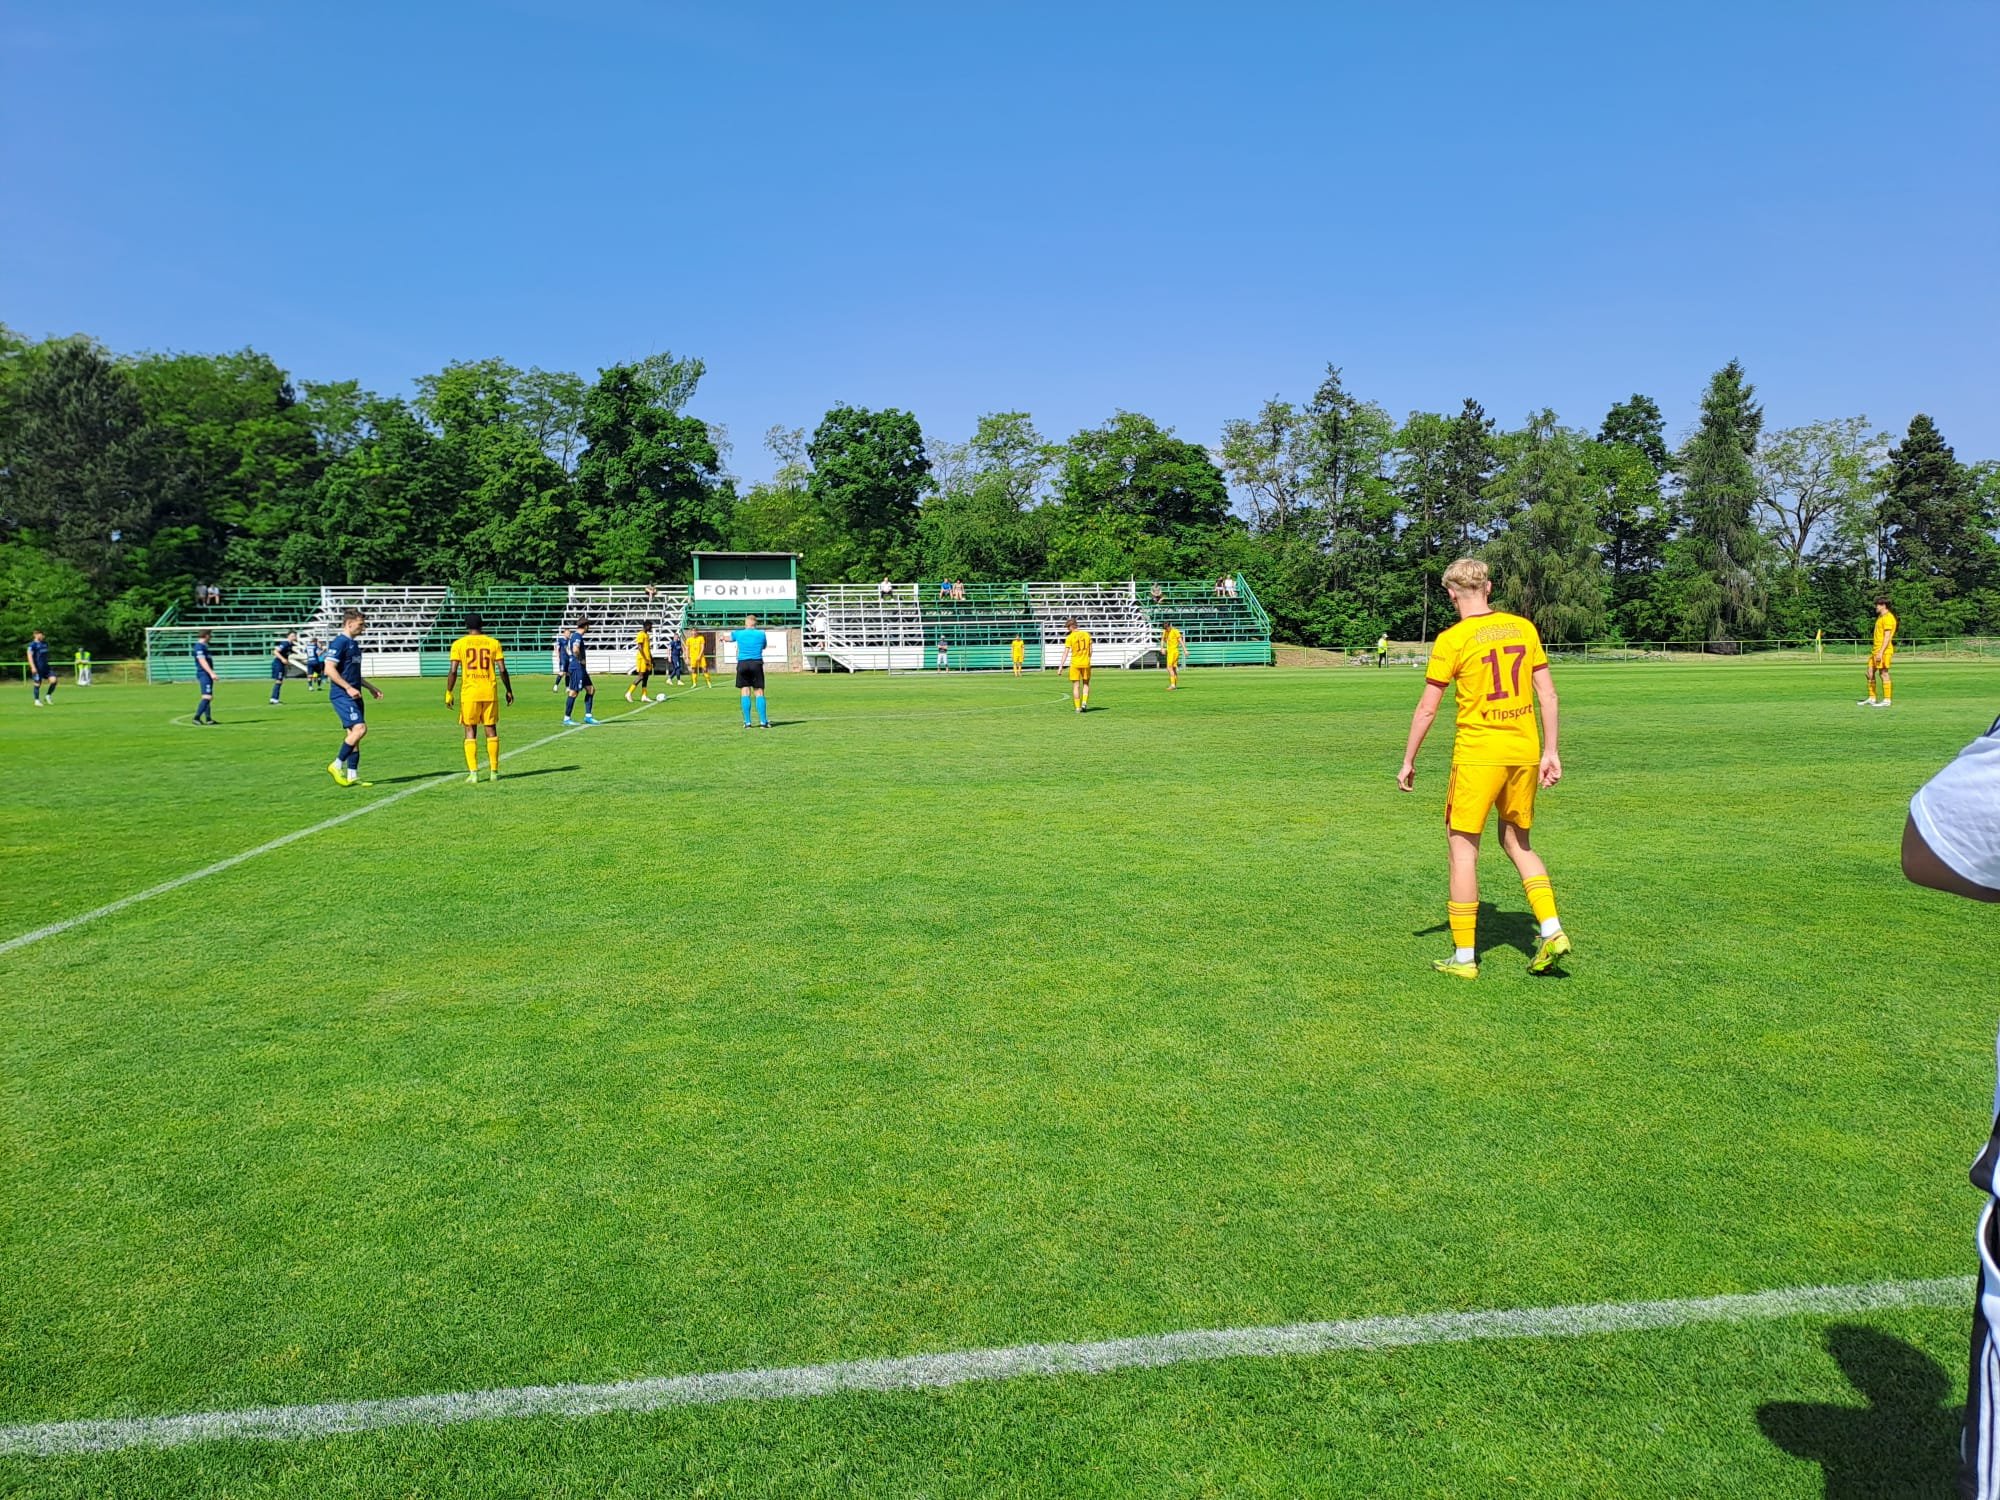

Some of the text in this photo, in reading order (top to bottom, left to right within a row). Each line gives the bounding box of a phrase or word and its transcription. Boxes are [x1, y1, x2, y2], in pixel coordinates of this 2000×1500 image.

[703, 585, 786, 595] FORTUNA
[466, 647, 491, 670] 26
[1481, 645, 1526, 701] 17
[1492, 704, 1533, 720] Tipsport
